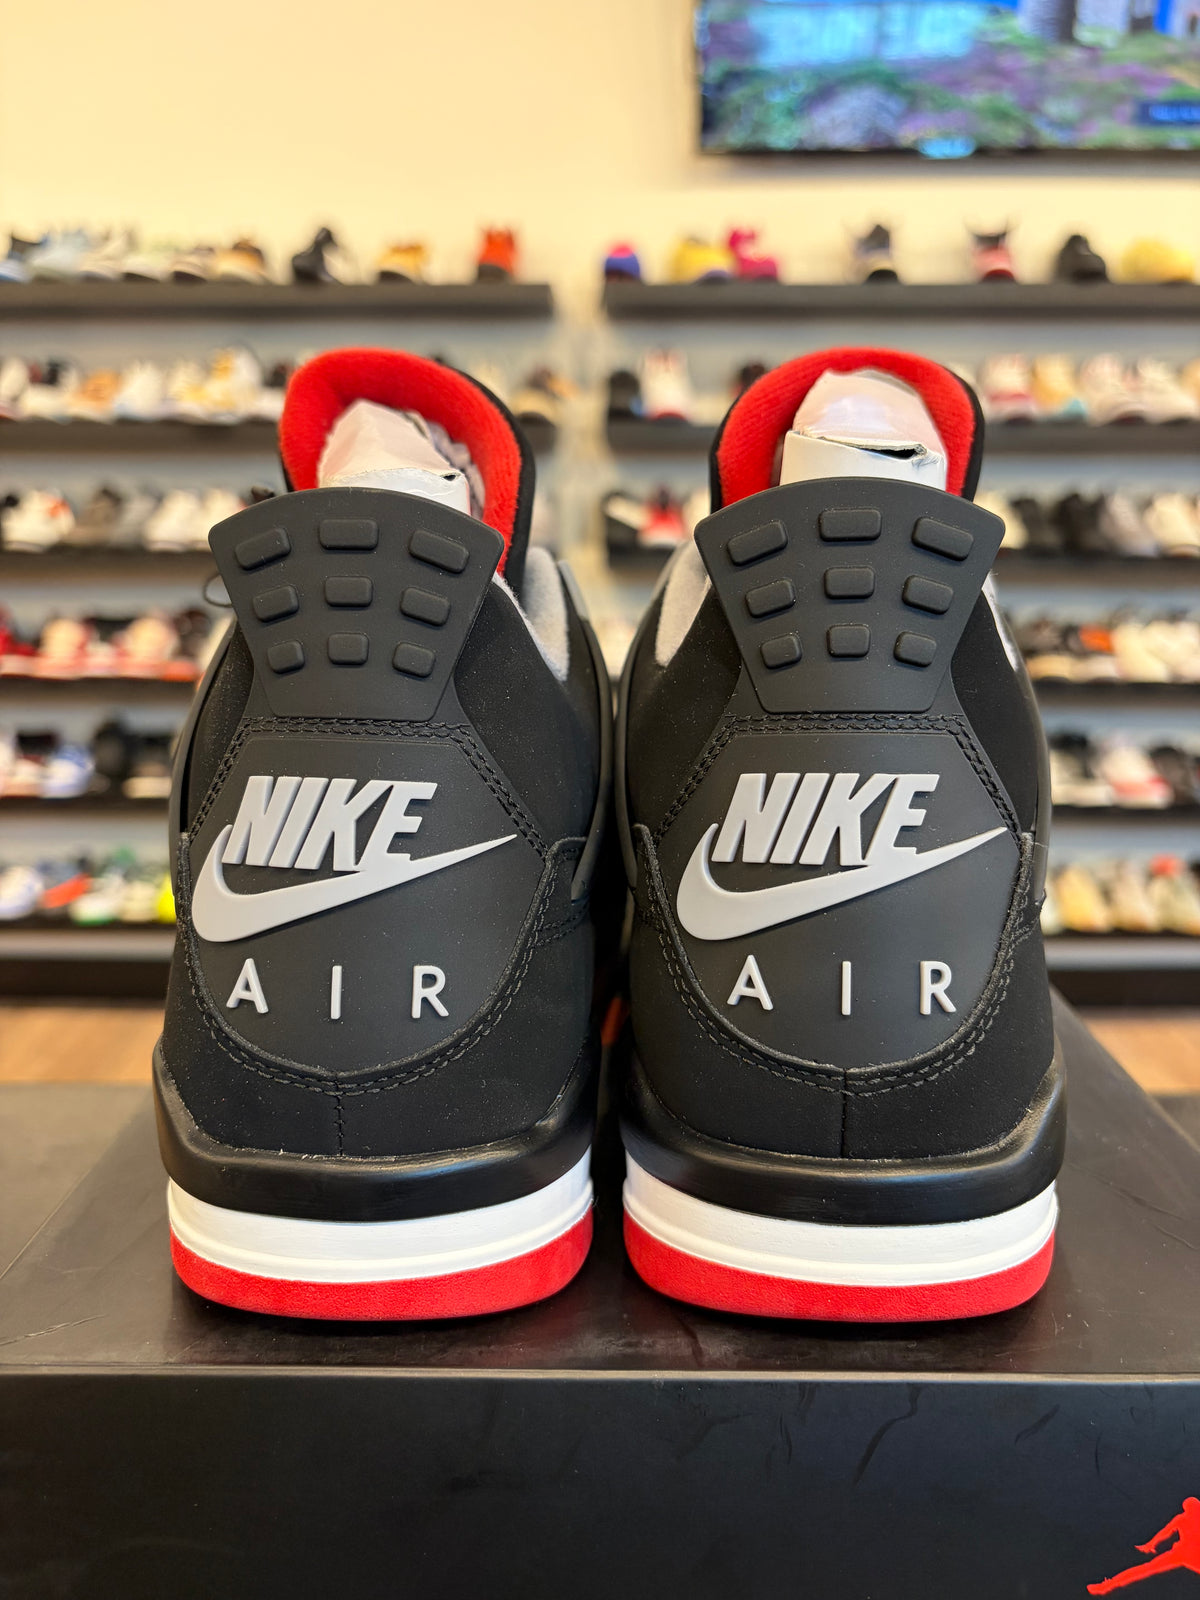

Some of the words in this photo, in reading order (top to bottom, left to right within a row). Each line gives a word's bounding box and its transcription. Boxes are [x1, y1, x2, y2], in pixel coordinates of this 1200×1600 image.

[222, 775, 438, 872] NIKE
[711, 773, 940, 866] NIKE
[226, 958, 450, 1020] AIR
[727, 955, 957, 1016] AIR
